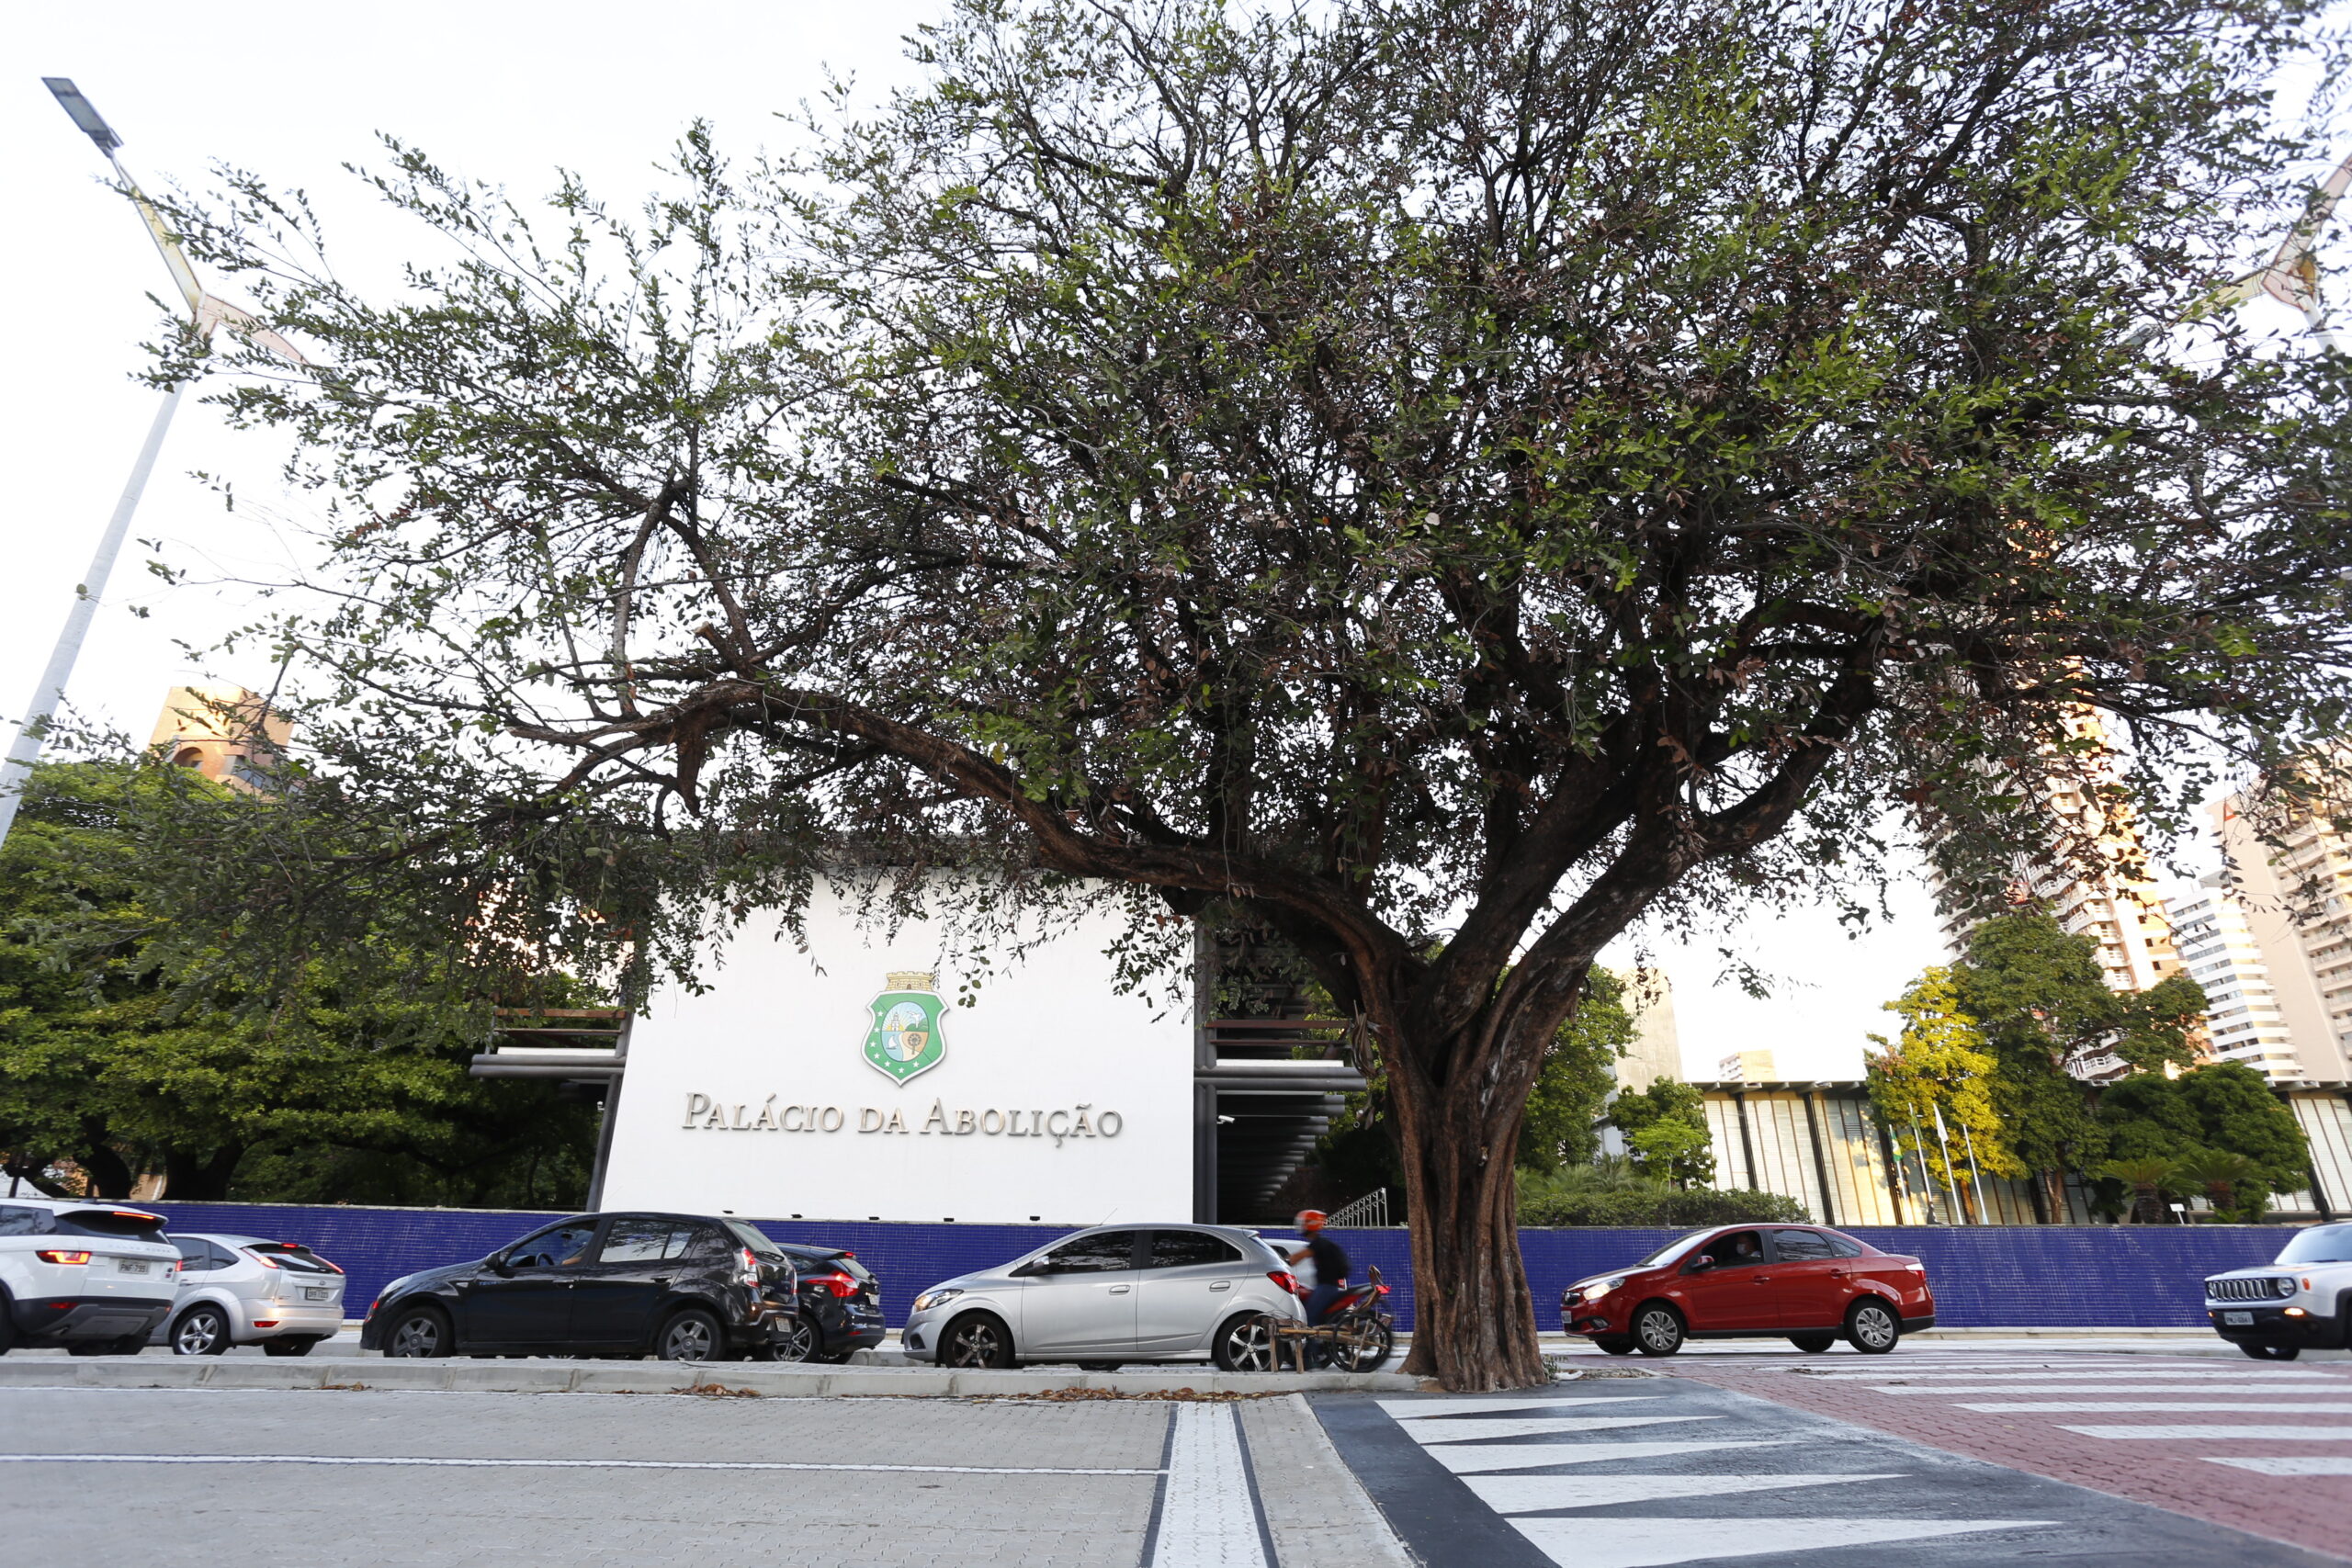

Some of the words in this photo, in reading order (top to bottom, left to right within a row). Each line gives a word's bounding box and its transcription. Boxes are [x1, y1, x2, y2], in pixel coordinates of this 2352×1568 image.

[683, 1092, 844, 1133] PALÁCIO
[857, 1107, 909, 1134] DA
[919, 1097, 1123, 1148] ABOLIÇÃO
